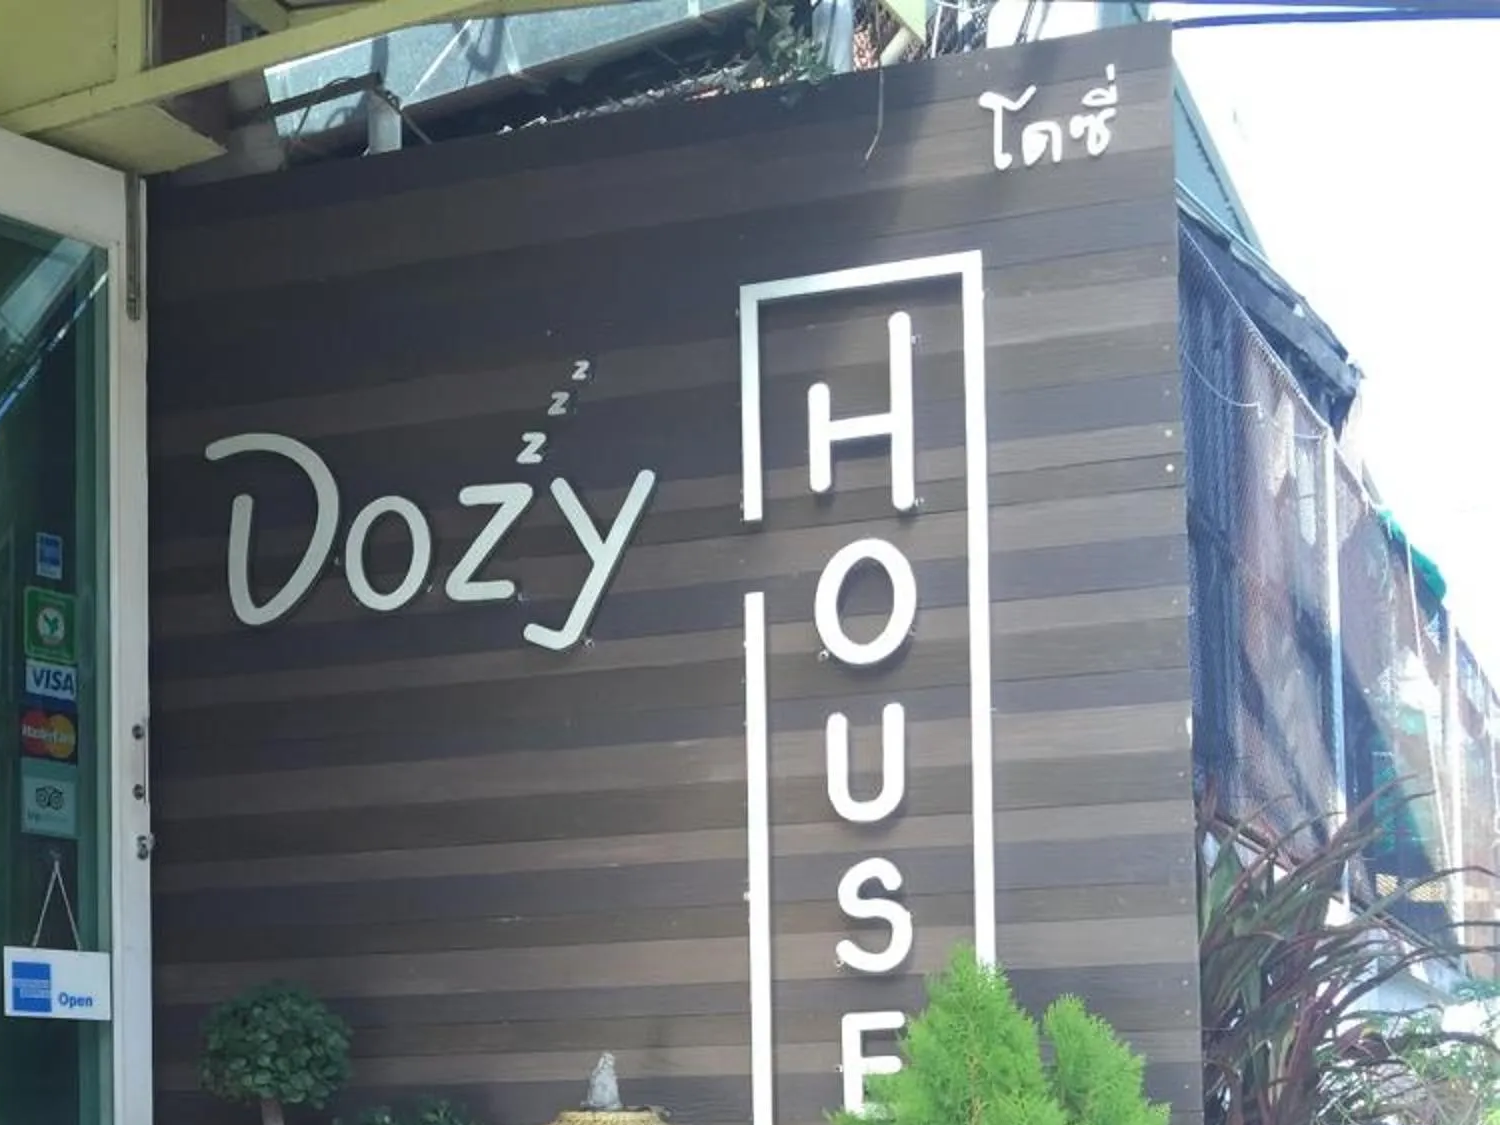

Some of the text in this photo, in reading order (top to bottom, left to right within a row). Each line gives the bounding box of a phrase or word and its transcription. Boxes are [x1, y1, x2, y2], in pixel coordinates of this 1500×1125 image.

[204, 432, 656, 651] Dozy
[32, 669, 76, 696] VISA
[806, 311, 918, 1120] HOUSE
[58, 991, 94, 1009] Open
